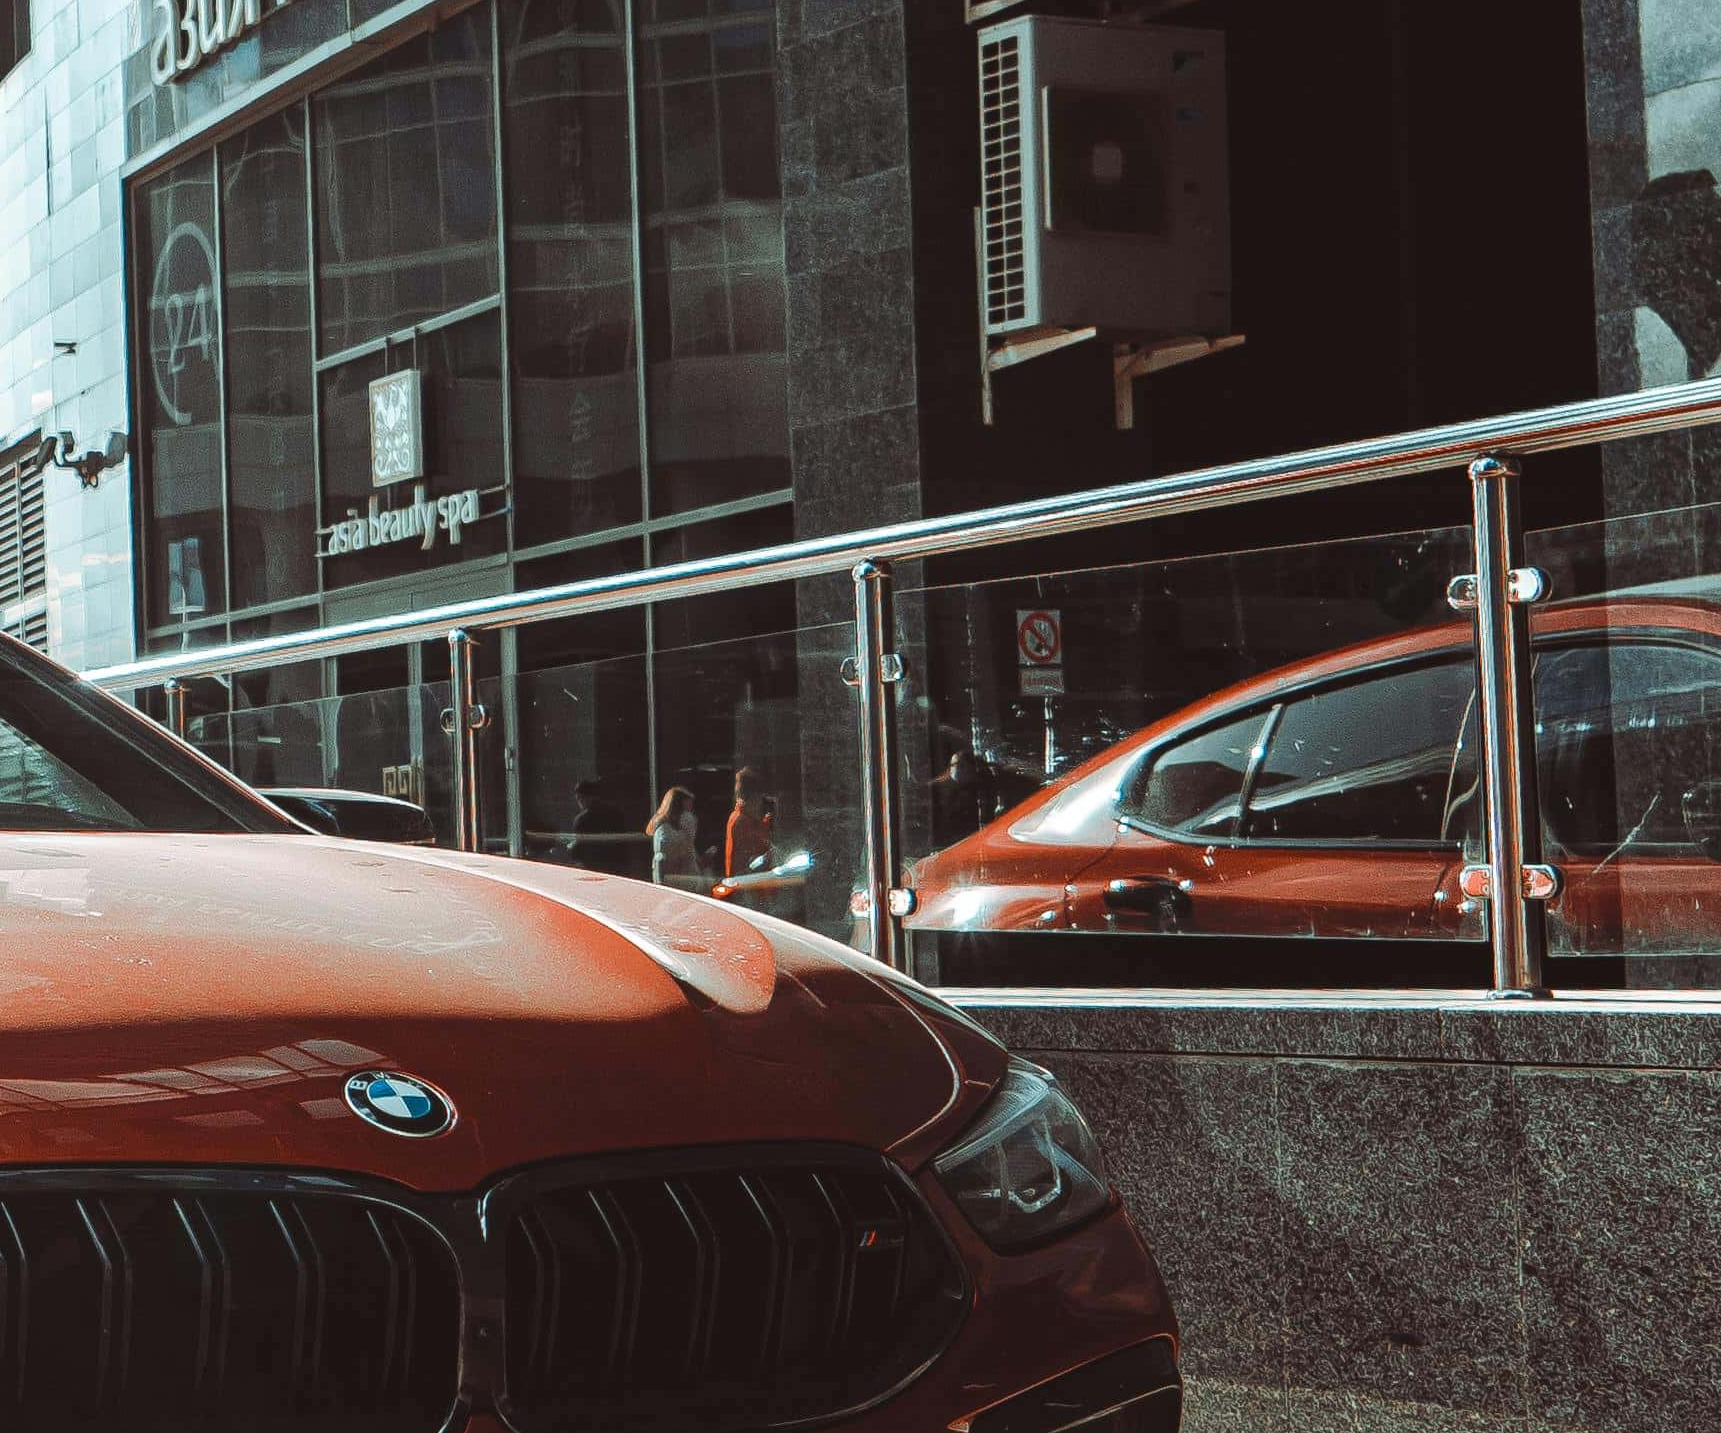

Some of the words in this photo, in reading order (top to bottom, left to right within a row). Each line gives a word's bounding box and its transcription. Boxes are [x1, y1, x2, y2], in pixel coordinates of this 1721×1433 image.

[328, 508, 369, 555] asia
[369, 485, 438, 551] beauty
[438, 488, 480, 546] spa
